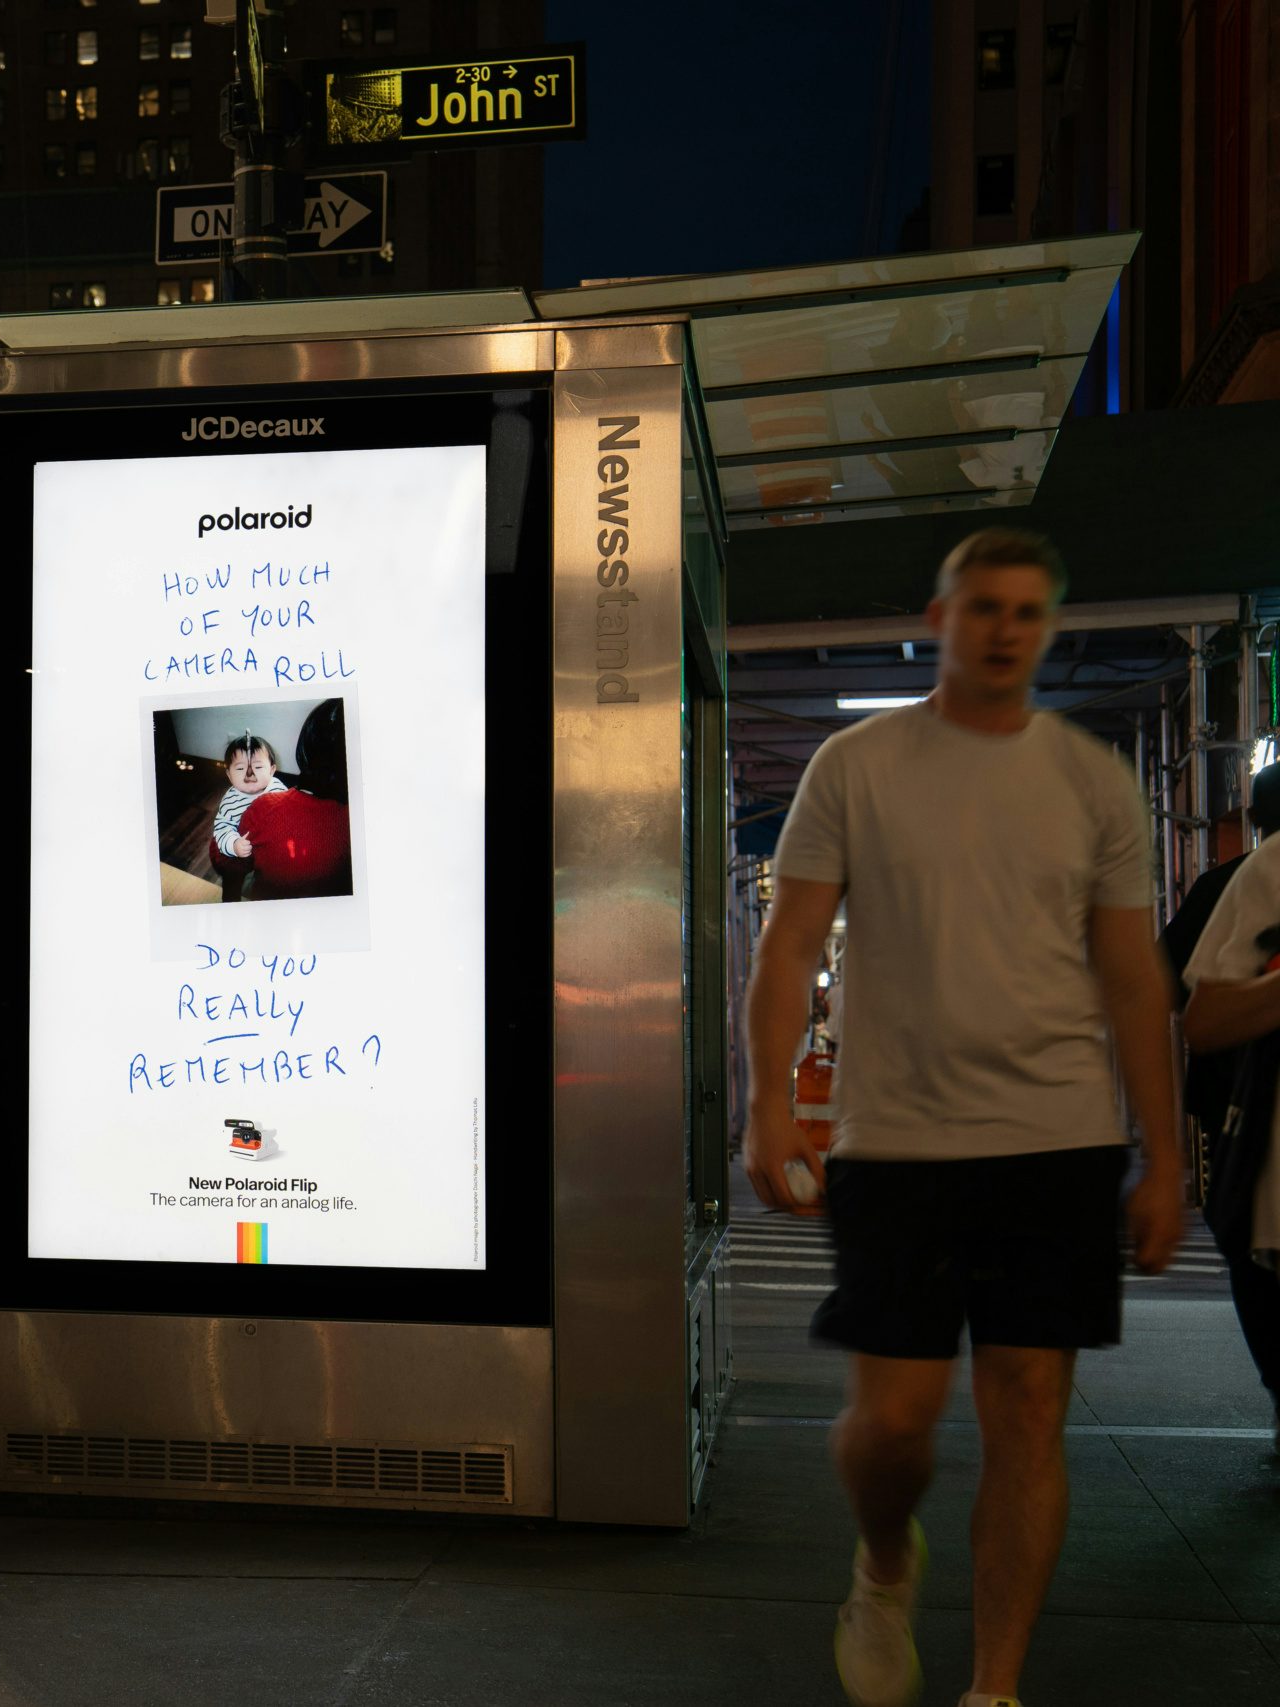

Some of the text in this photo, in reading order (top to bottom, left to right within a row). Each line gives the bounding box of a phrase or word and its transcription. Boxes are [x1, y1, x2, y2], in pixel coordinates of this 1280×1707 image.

[455, 66, 491, 84] 2-30
[416, 74, 559, 127] John ST
[191, 199, 349, 238] ON AY
[181, 417, 325, 441] JCDecaux
[198, 504, 313, 538] polaroid
[597, 415, 640, 704] Newsstand
[163, 561, 331, 602] HOW MUCH
[179, 600, 315, 637] OF YOUR
[144, 648, 356, 687] CAMERA ROLL
[194, 943, 317, 982] DO YOU
[178, 984, 304, 1036] REALLY
[149, 1192, 357, 1212] The camera for an analog life.
[188, 1177, 318, 1194] New Polaroid Flip
